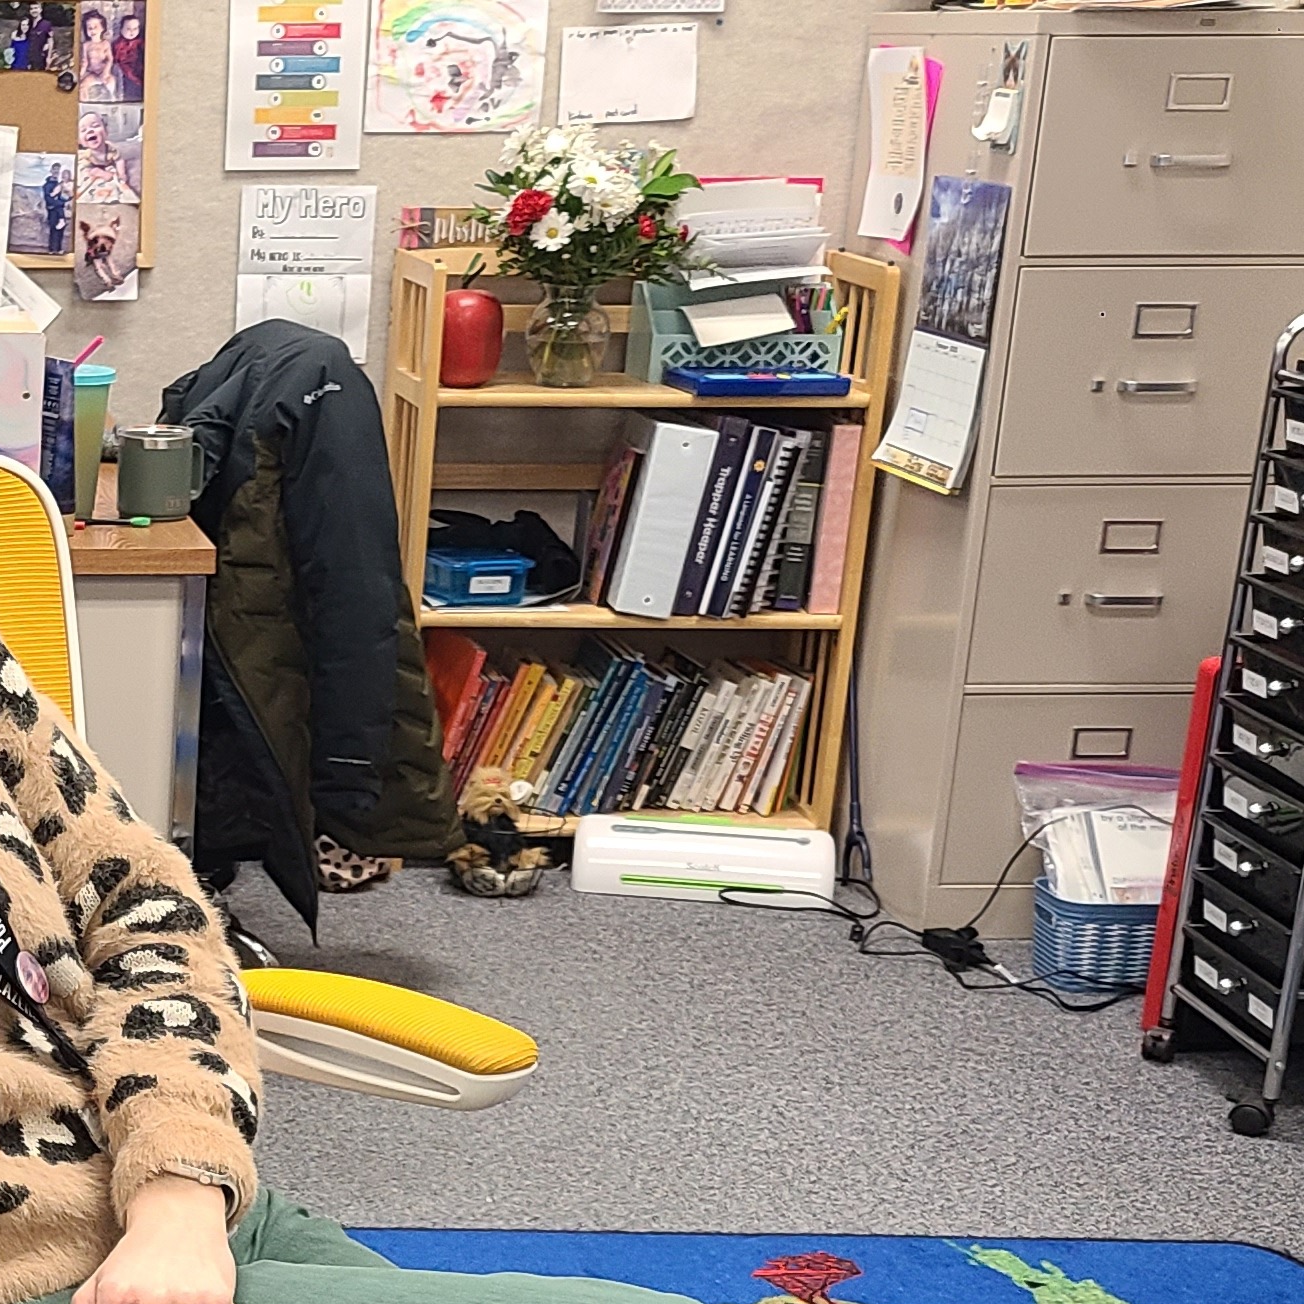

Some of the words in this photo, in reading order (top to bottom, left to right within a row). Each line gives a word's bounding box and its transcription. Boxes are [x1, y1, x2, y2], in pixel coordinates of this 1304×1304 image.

[256, 188, 293, 225] My
[299, 188, 366, 218] Hero
[709, 466, 731, 515] Trapper
[695, 517, 717, 564] Keeper
[721, 541, 738, 581] LEARNING
